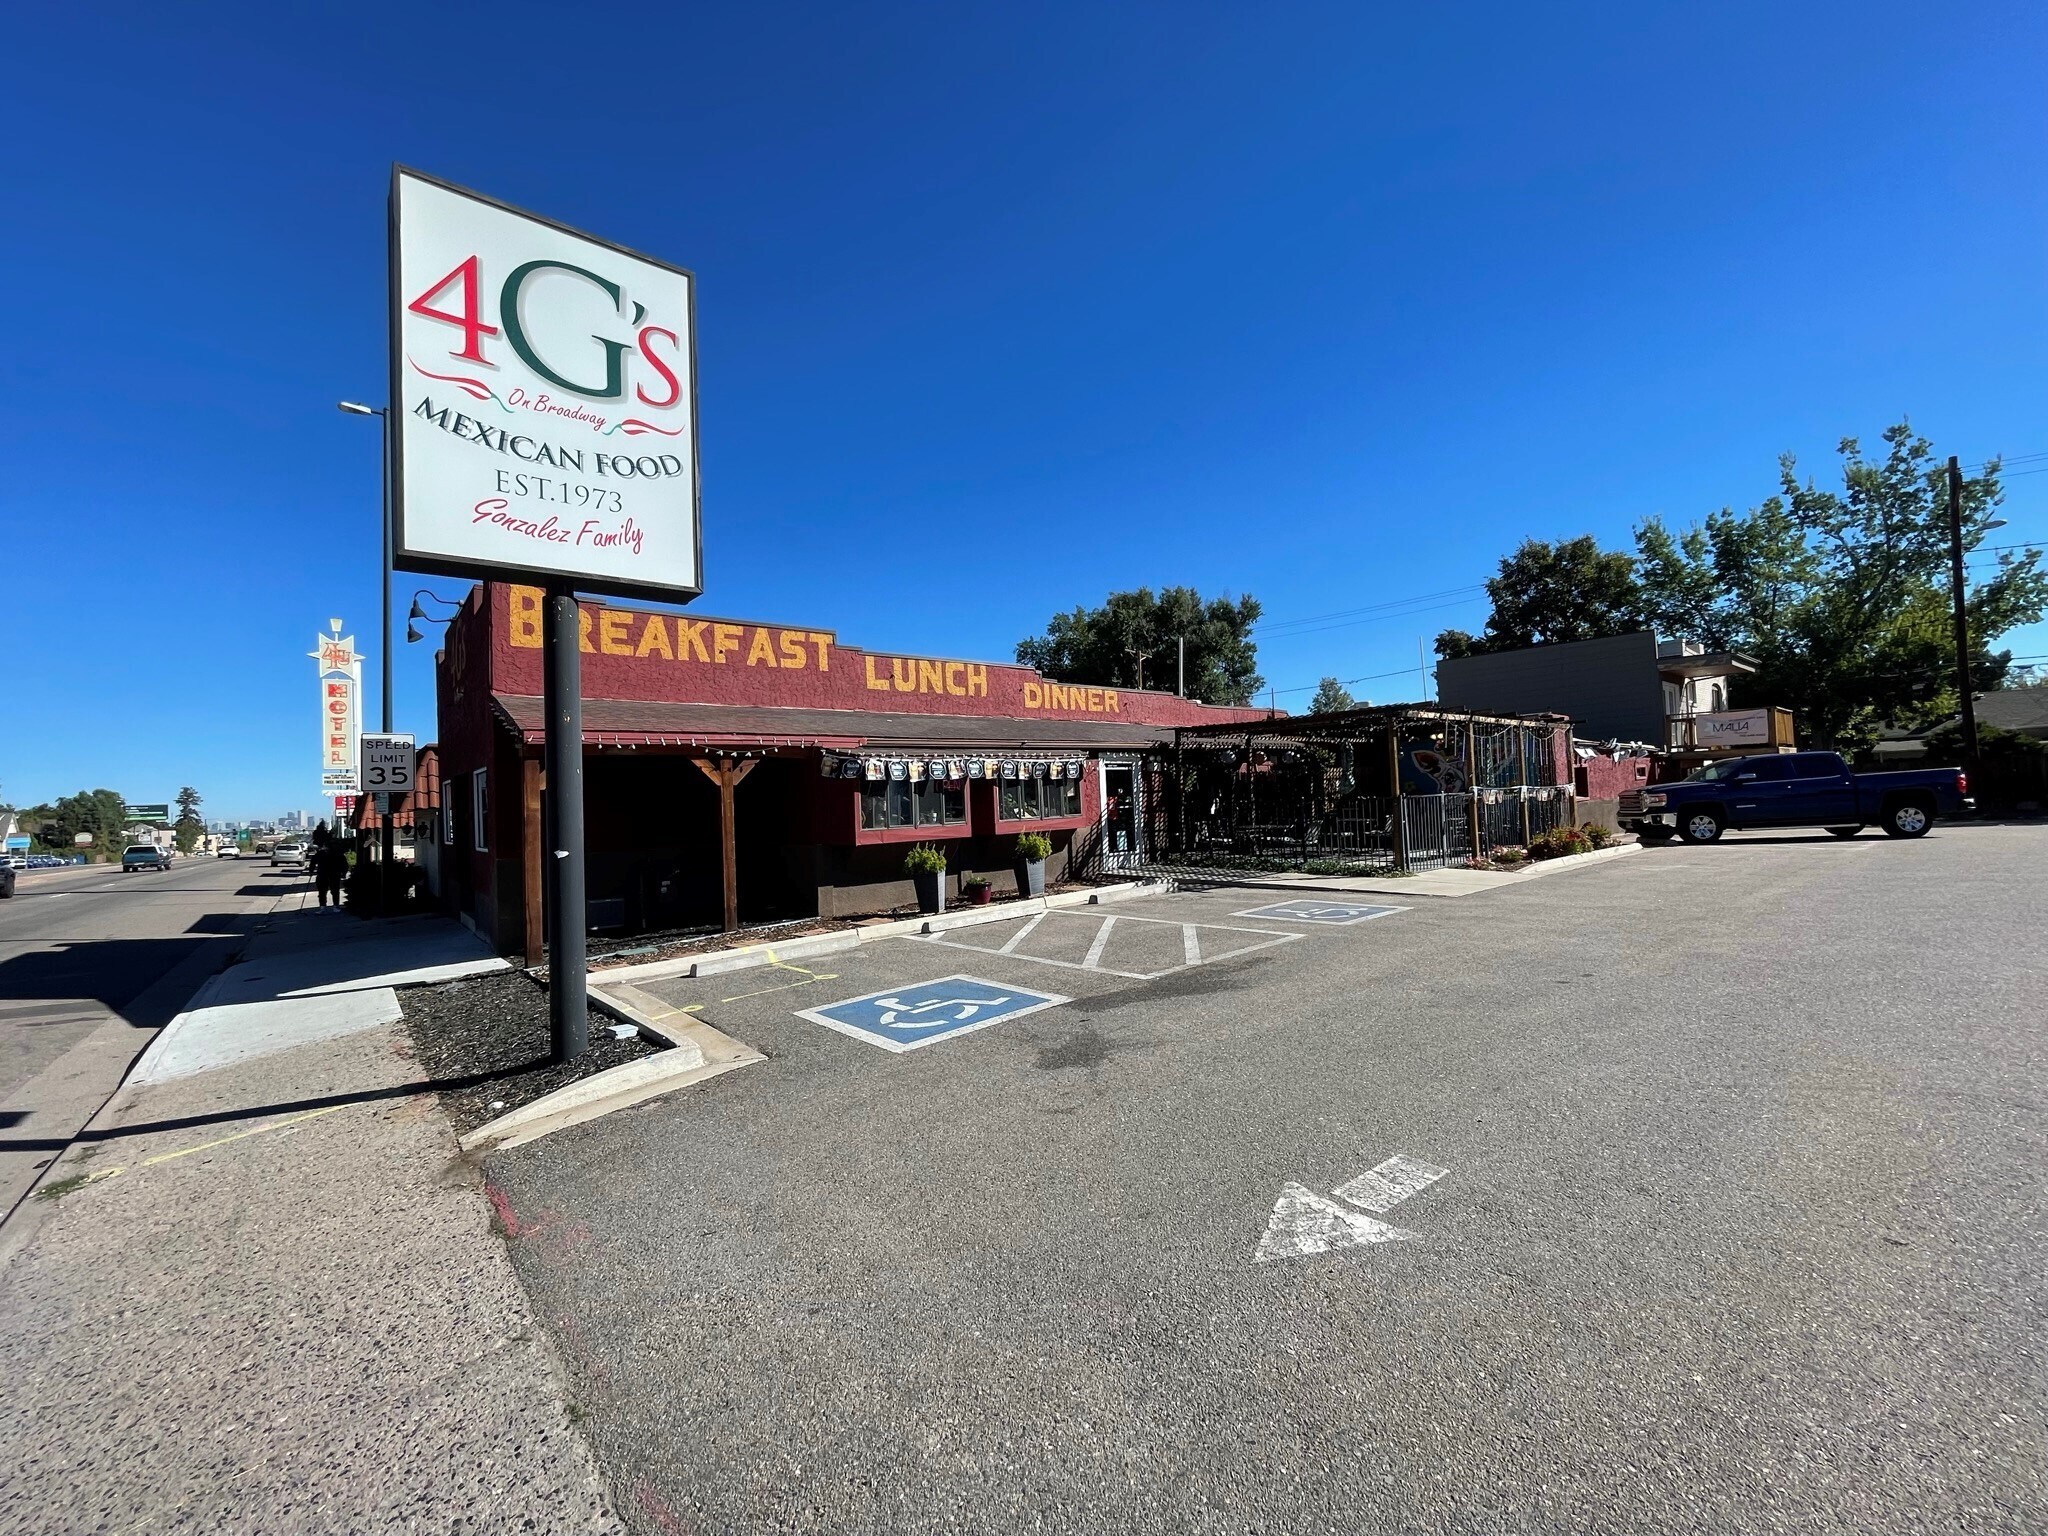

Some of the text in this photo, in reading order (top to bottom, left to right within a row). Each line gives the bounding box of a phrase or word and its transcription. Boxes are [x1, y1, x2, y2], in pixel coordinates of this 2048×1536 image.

[408, 255, 680, 408] 4G's
[412, 396, 682, 477] MEXICAN FOOD
[508, 388, 606, 431] On Broadway
[473, 498, 643, 554] Gonzalez Family
[865, 656, 988, 697] LUNCH
[1023, 682, 1120, 713] DINNER
[327, 684, 347, 765] MOTEL
[366, 741, 411, 750] SPEED
[368, 767, 408, 785] 35
[371, 755, 406, 763] LIMIT
